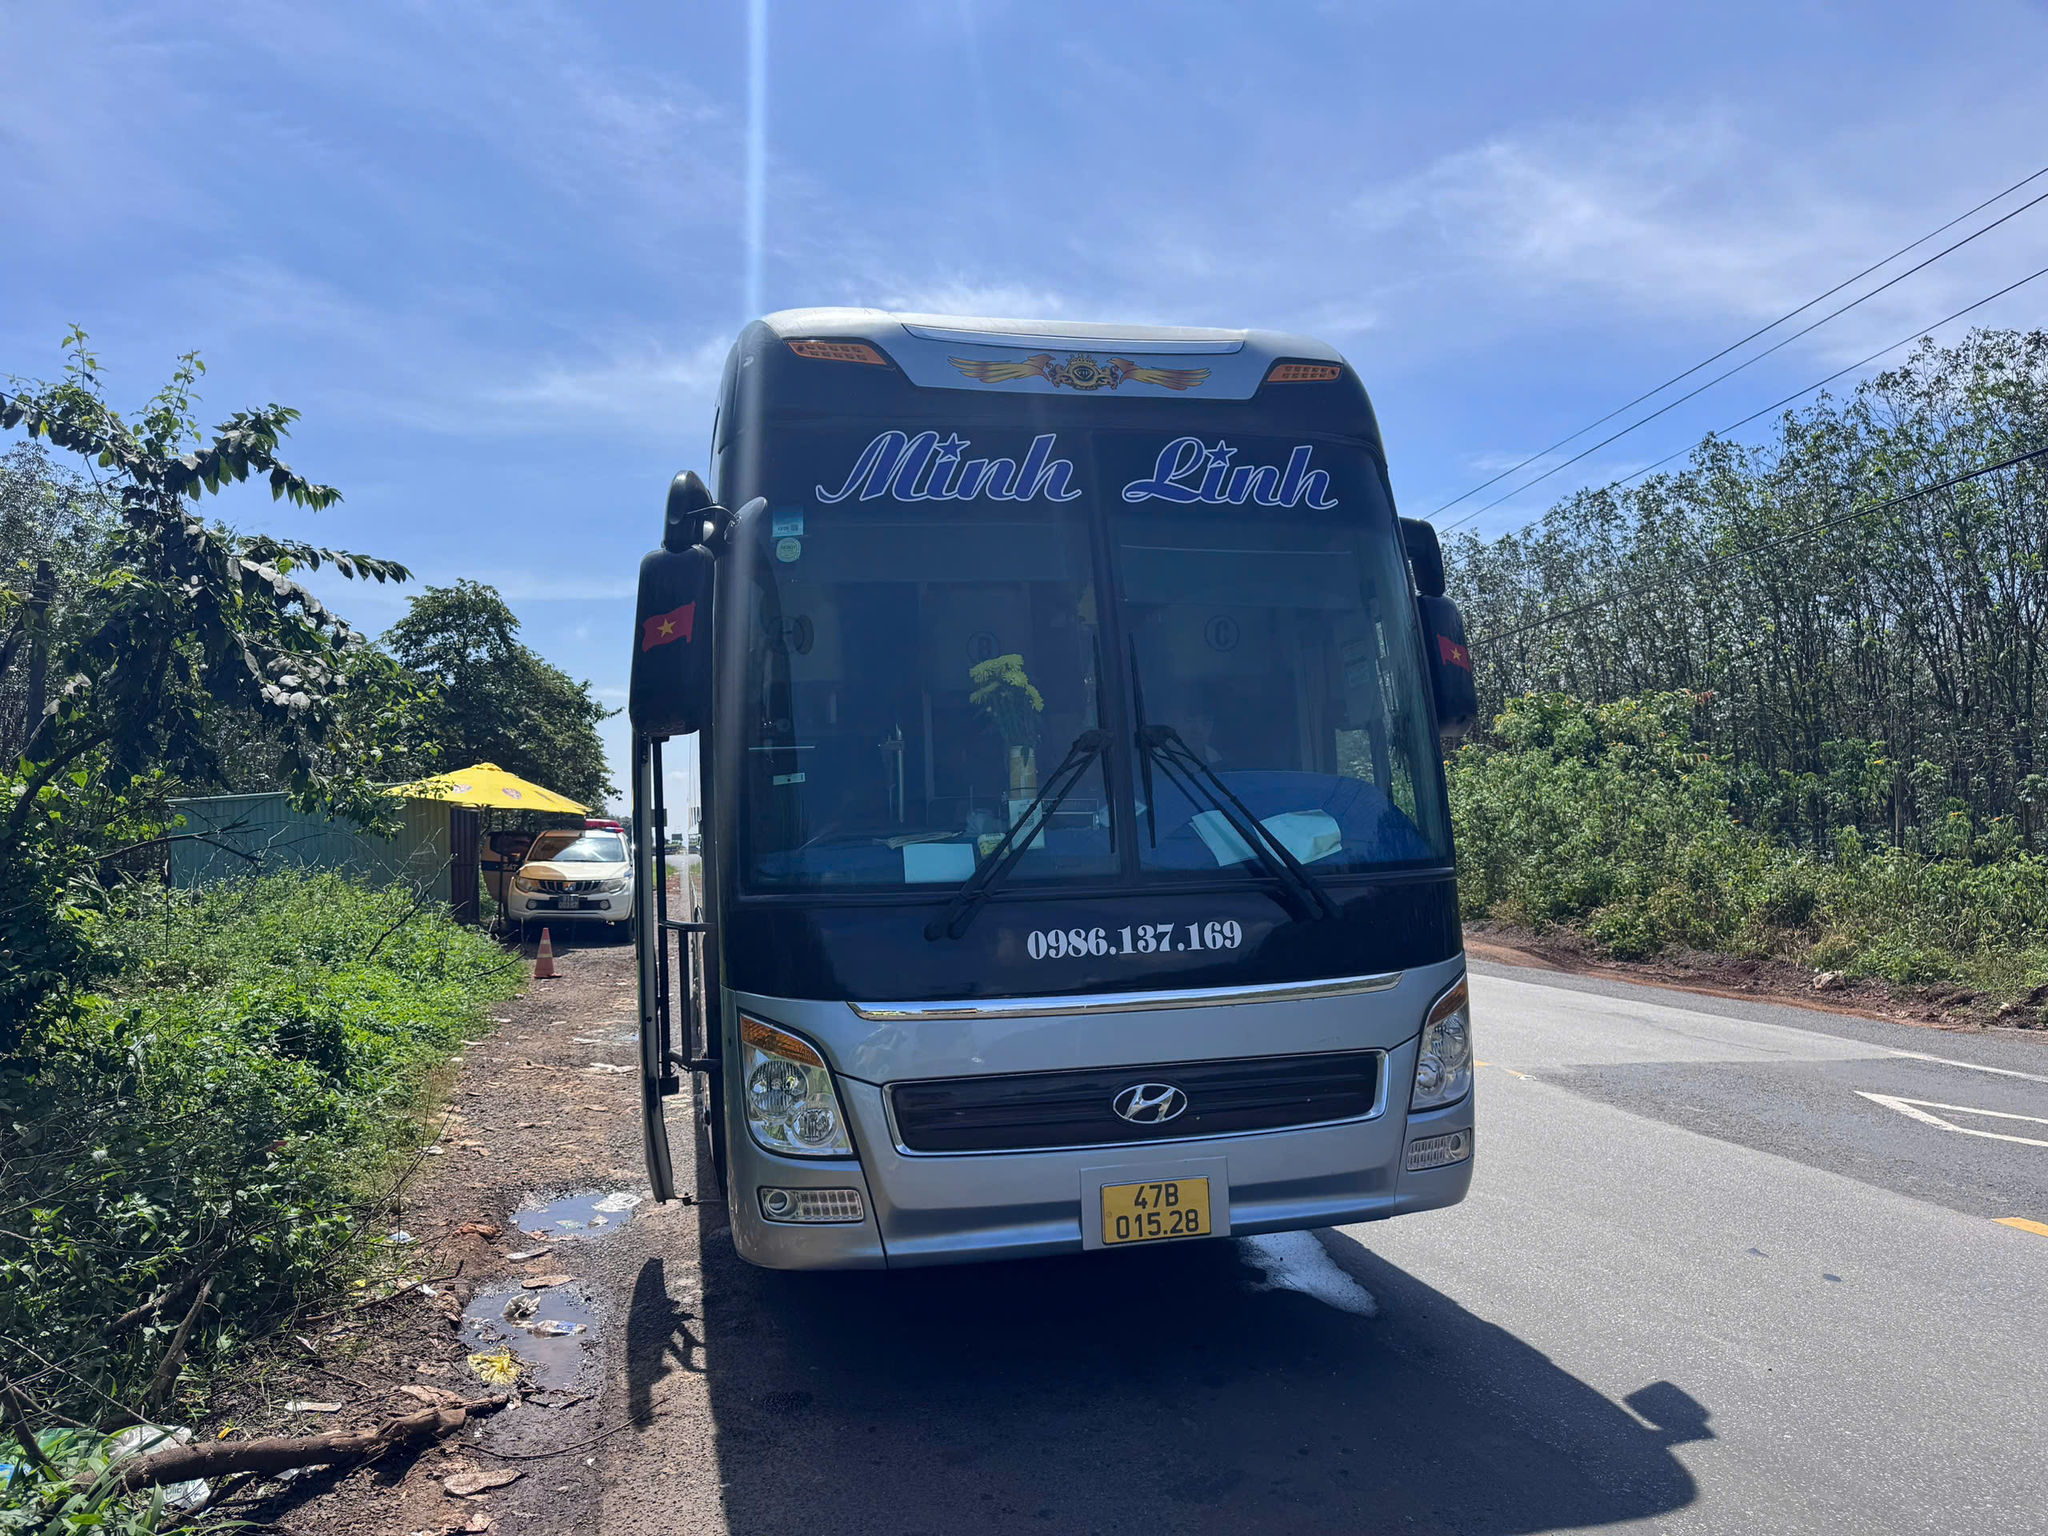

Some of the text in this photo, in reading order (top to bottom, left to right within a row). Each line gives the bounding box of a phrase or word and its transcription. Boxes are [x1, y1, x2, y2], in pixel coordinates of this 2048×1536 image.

[815, 430, 1339, 510] Minh Linh
[1027, 920, 1243, 960] 0986.137.169
[1134, 1182, 1179, 1209] 47B
[1116, 1208, 1199, 1239] 015.28
